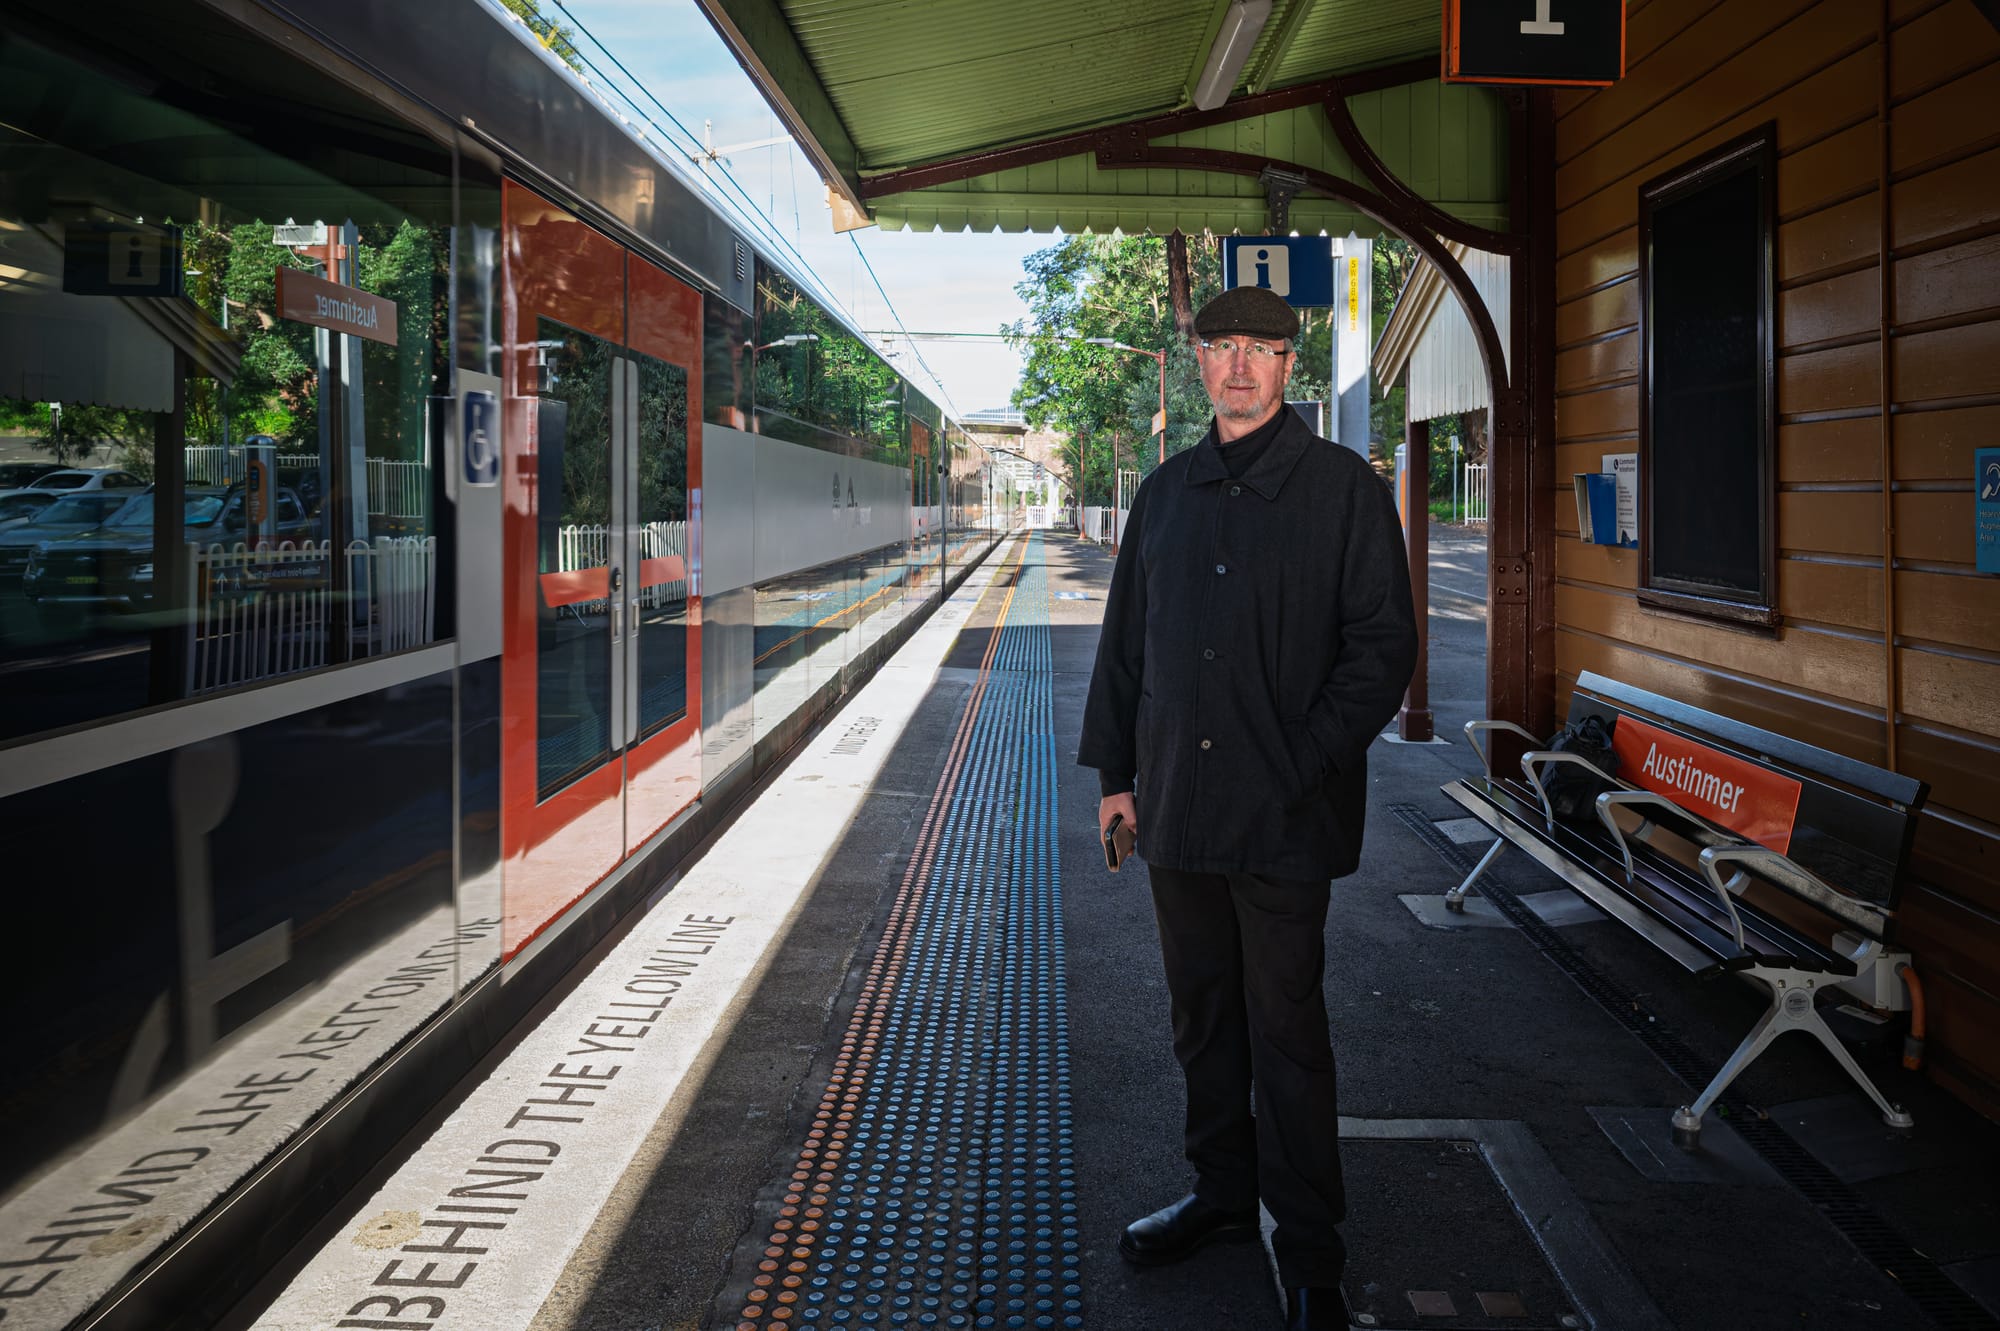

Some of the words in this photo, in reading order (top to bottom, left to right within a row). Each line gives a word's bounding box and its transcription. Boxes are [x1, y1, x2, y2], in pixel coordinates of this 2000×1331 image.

[1641, 742, 1745, 814] Austinmer
[336, 1138, 562, 1331] BEHIND
[504, 1062, 622, 1129] THE
[567, 956, 699, 1056] YELLOW
[656, 913, 736, 956] LINE
